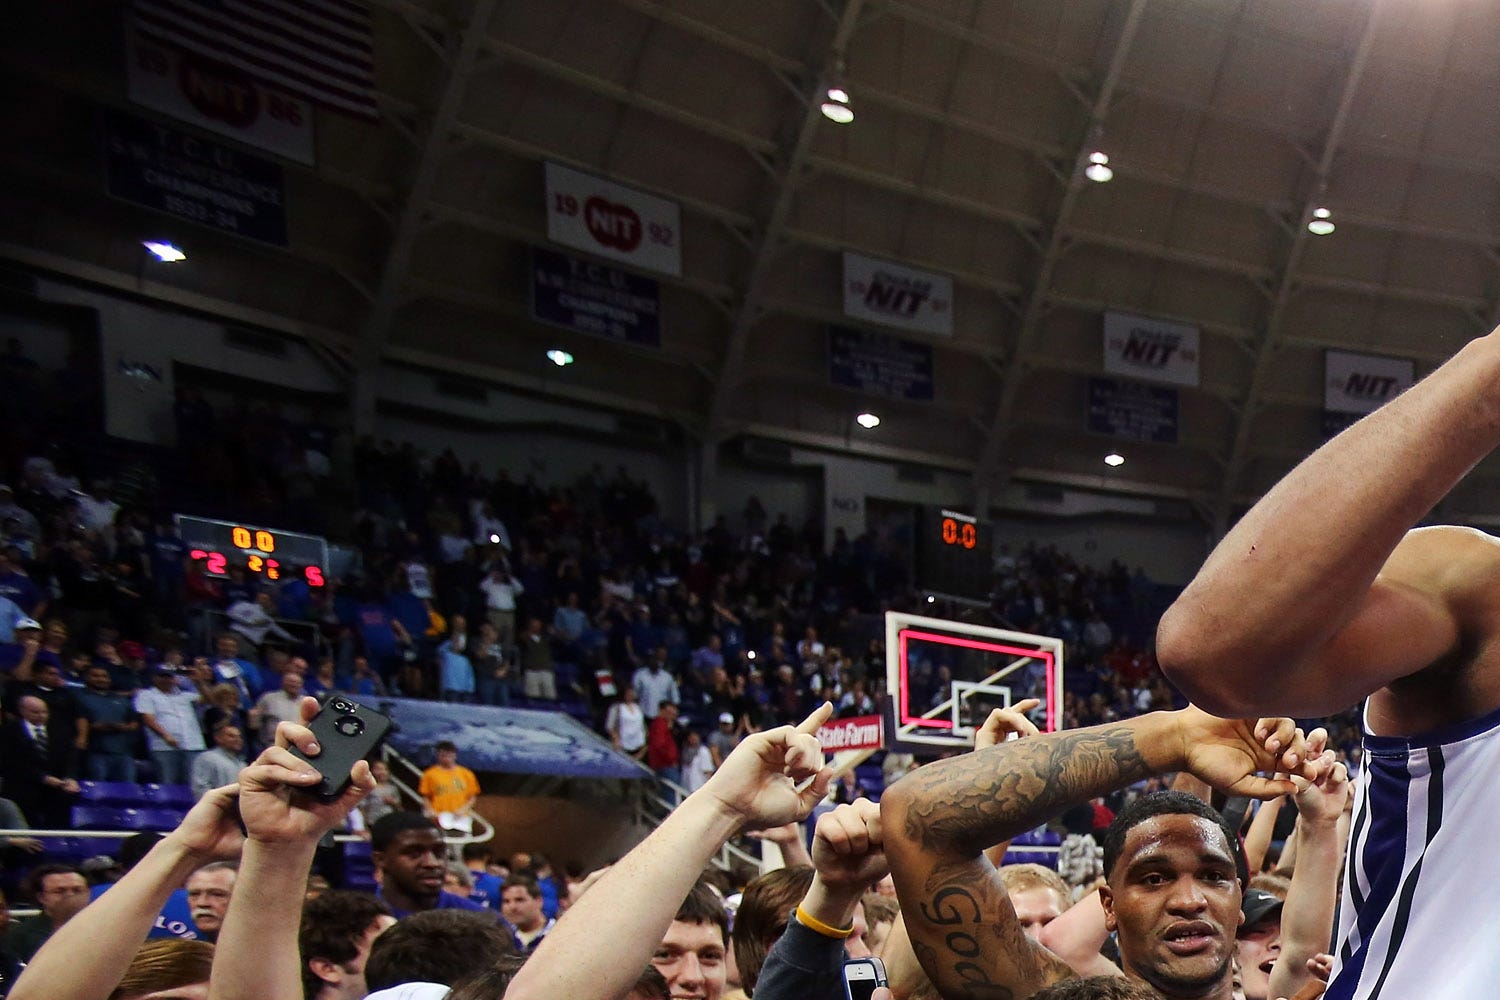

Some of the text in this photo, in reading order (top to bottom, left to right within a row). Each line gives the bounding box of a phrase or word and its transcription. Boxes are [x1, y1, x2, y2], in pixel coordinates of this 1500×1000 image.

[555, 193, 579, 217] 19
[590, 204, 634, 242] NIT
[865, 281, 930, 315] NIT
[1122, 340, 1180, 366] NIT
[1345, 373, 1398, 398] NIT
[920, 886, 1014, 1000] God
